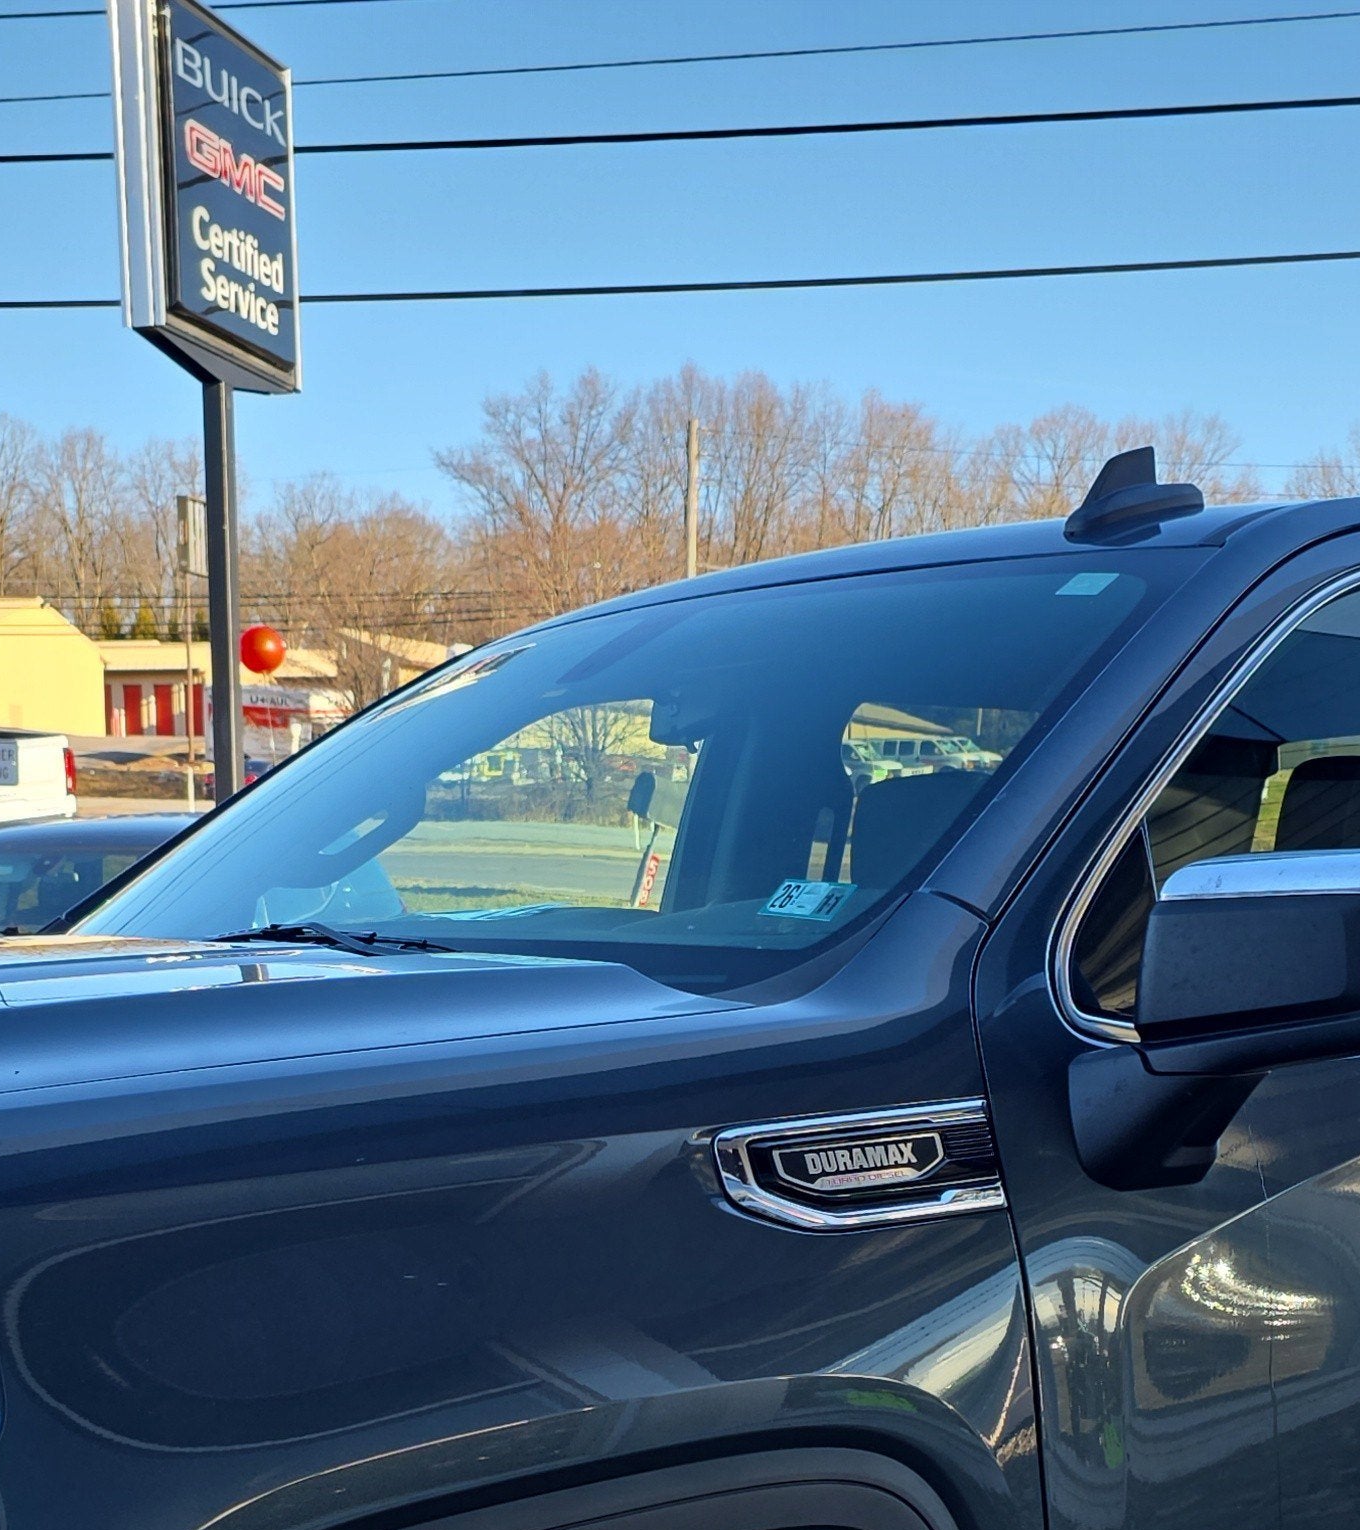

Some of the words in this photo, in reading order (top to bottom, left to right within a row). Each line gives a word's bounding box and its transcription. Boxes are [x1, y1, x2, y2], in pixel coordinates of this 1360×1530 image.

[174, 37, 287, 148] BUICK
[184, 118, 286, 222] GMC
[192, 205, 285, 296] Certified
[199, 257, 280, 337] Service
[250, 695, 290, 707] U-AUL
[804, 1141, 918, 1175] DURAMAX
[868, 1170, 909, 1180] DIESEL
